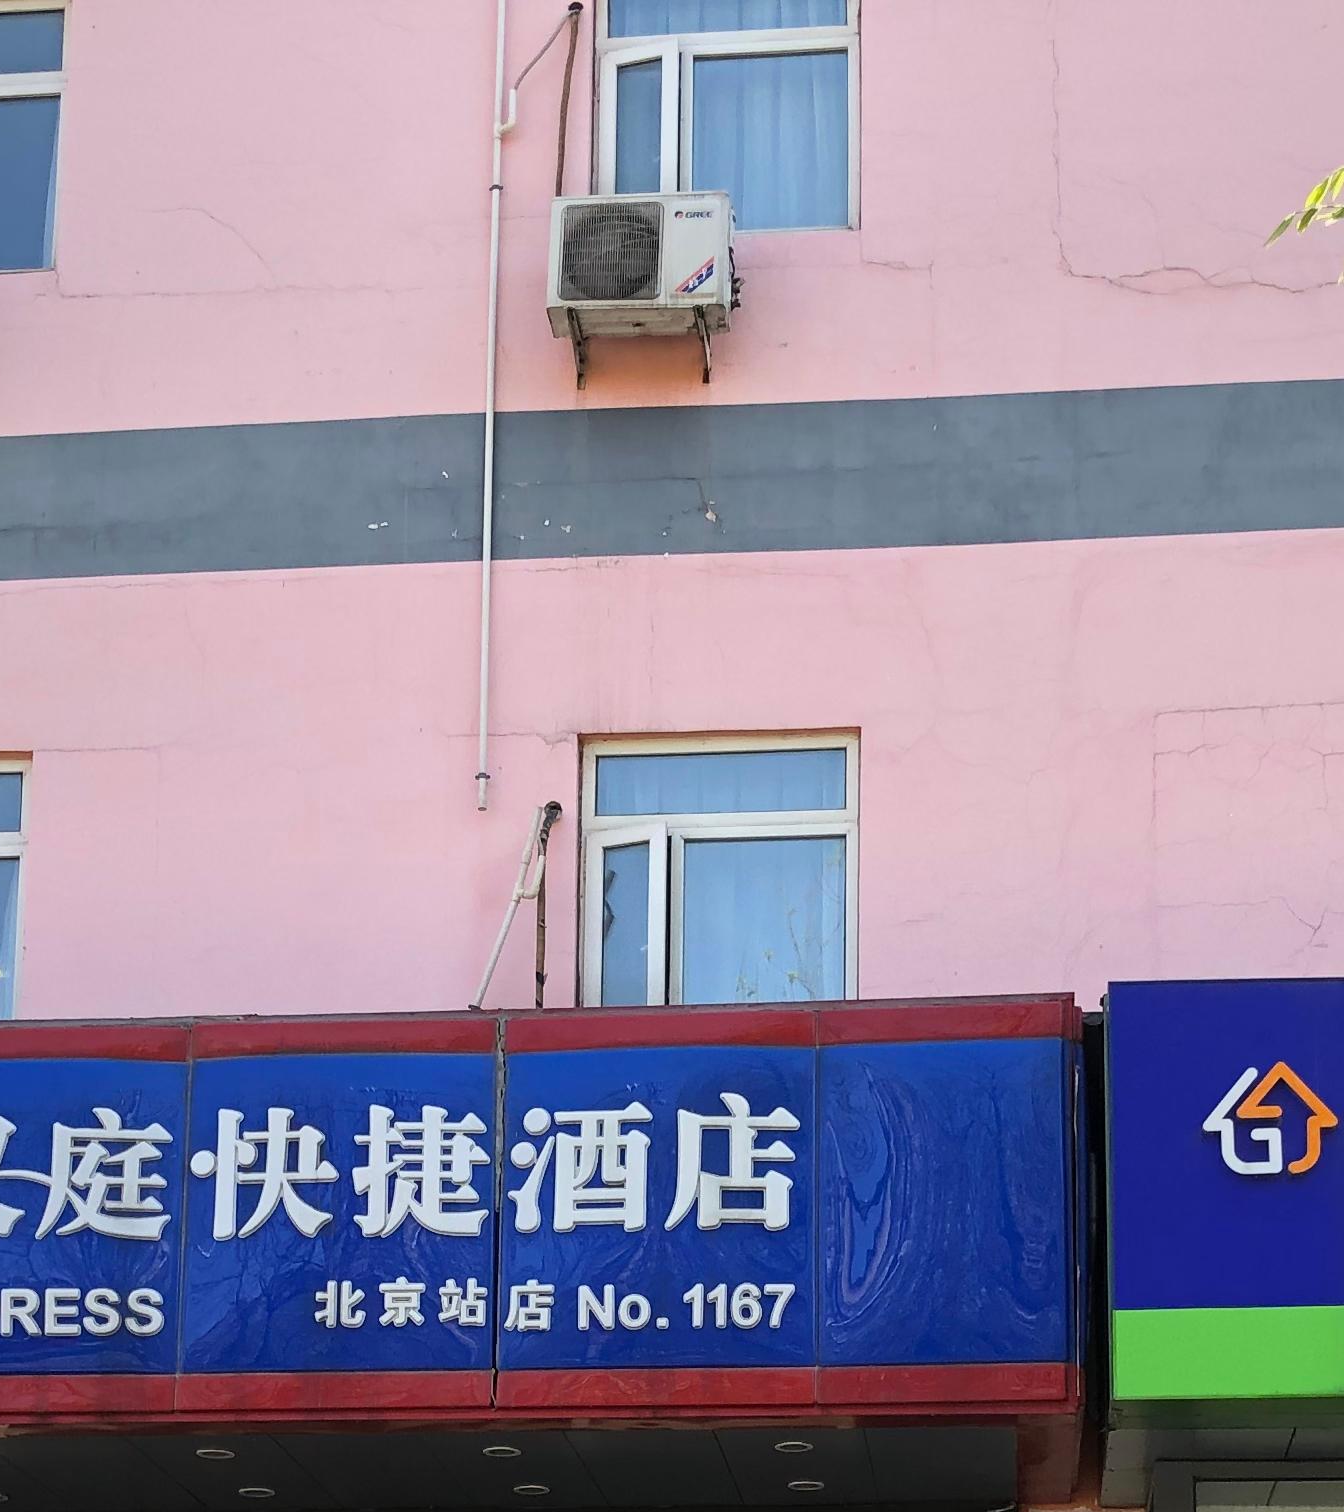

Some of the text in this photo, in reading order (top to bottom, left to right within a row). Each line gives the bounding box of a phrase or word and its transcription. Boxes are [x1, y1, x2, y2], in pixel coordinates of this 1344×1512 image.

[315, 1276, 796, 1333] 北京站店 No. 1167
